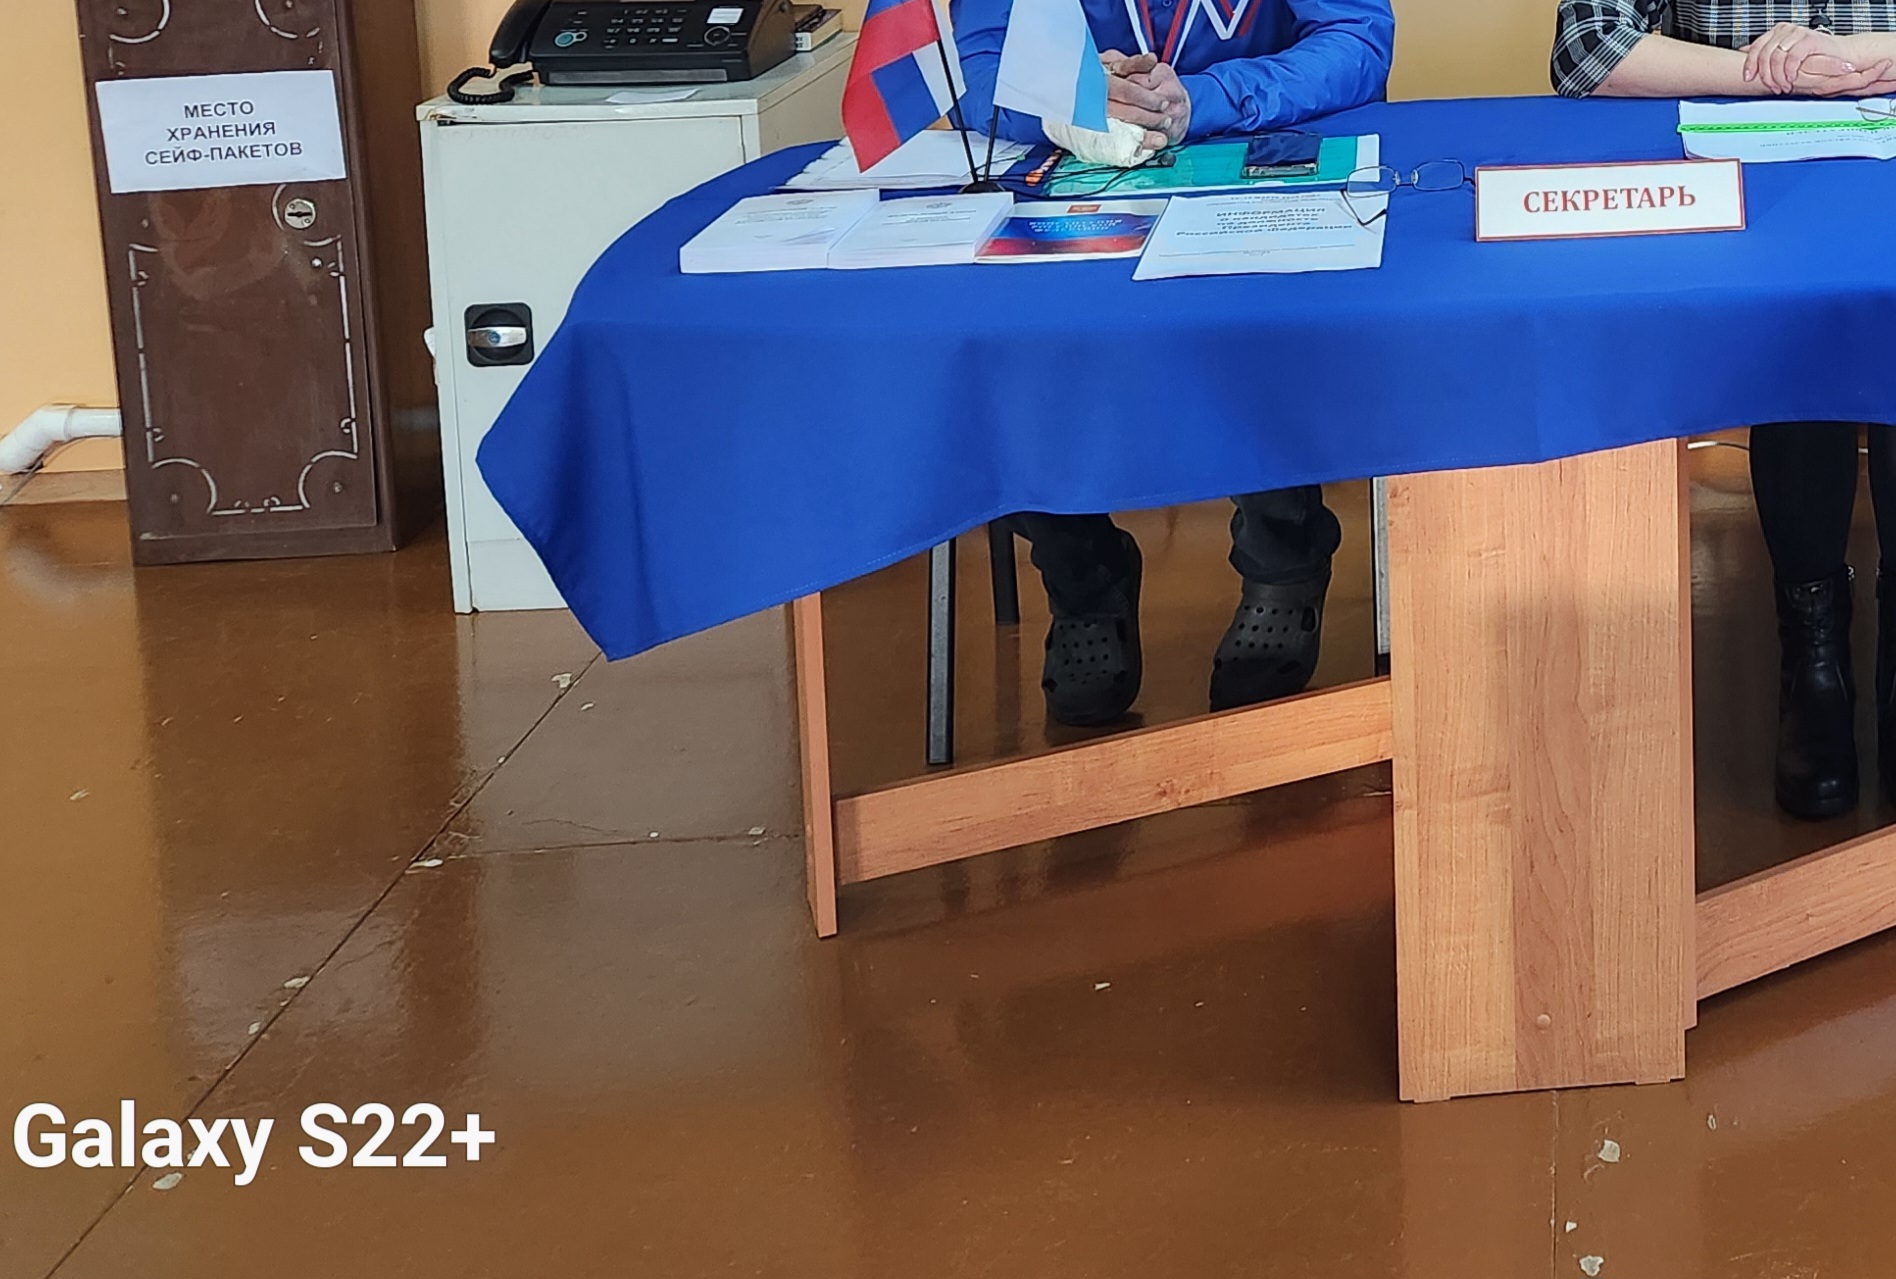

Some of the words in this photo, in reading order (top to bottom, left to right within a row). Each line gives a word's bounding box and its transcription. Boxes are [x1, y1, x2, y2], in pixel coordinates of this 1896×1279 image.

[183, 101, 254, 119] МЕСТО
[167, 122, 276, 141] ХРАНЕНИЯ
[145, 142, 302, 165] СЕЙФ-ПАКЕТОВ
[1523, 185, 1696, 213] СЕКРЕТАРЬ
